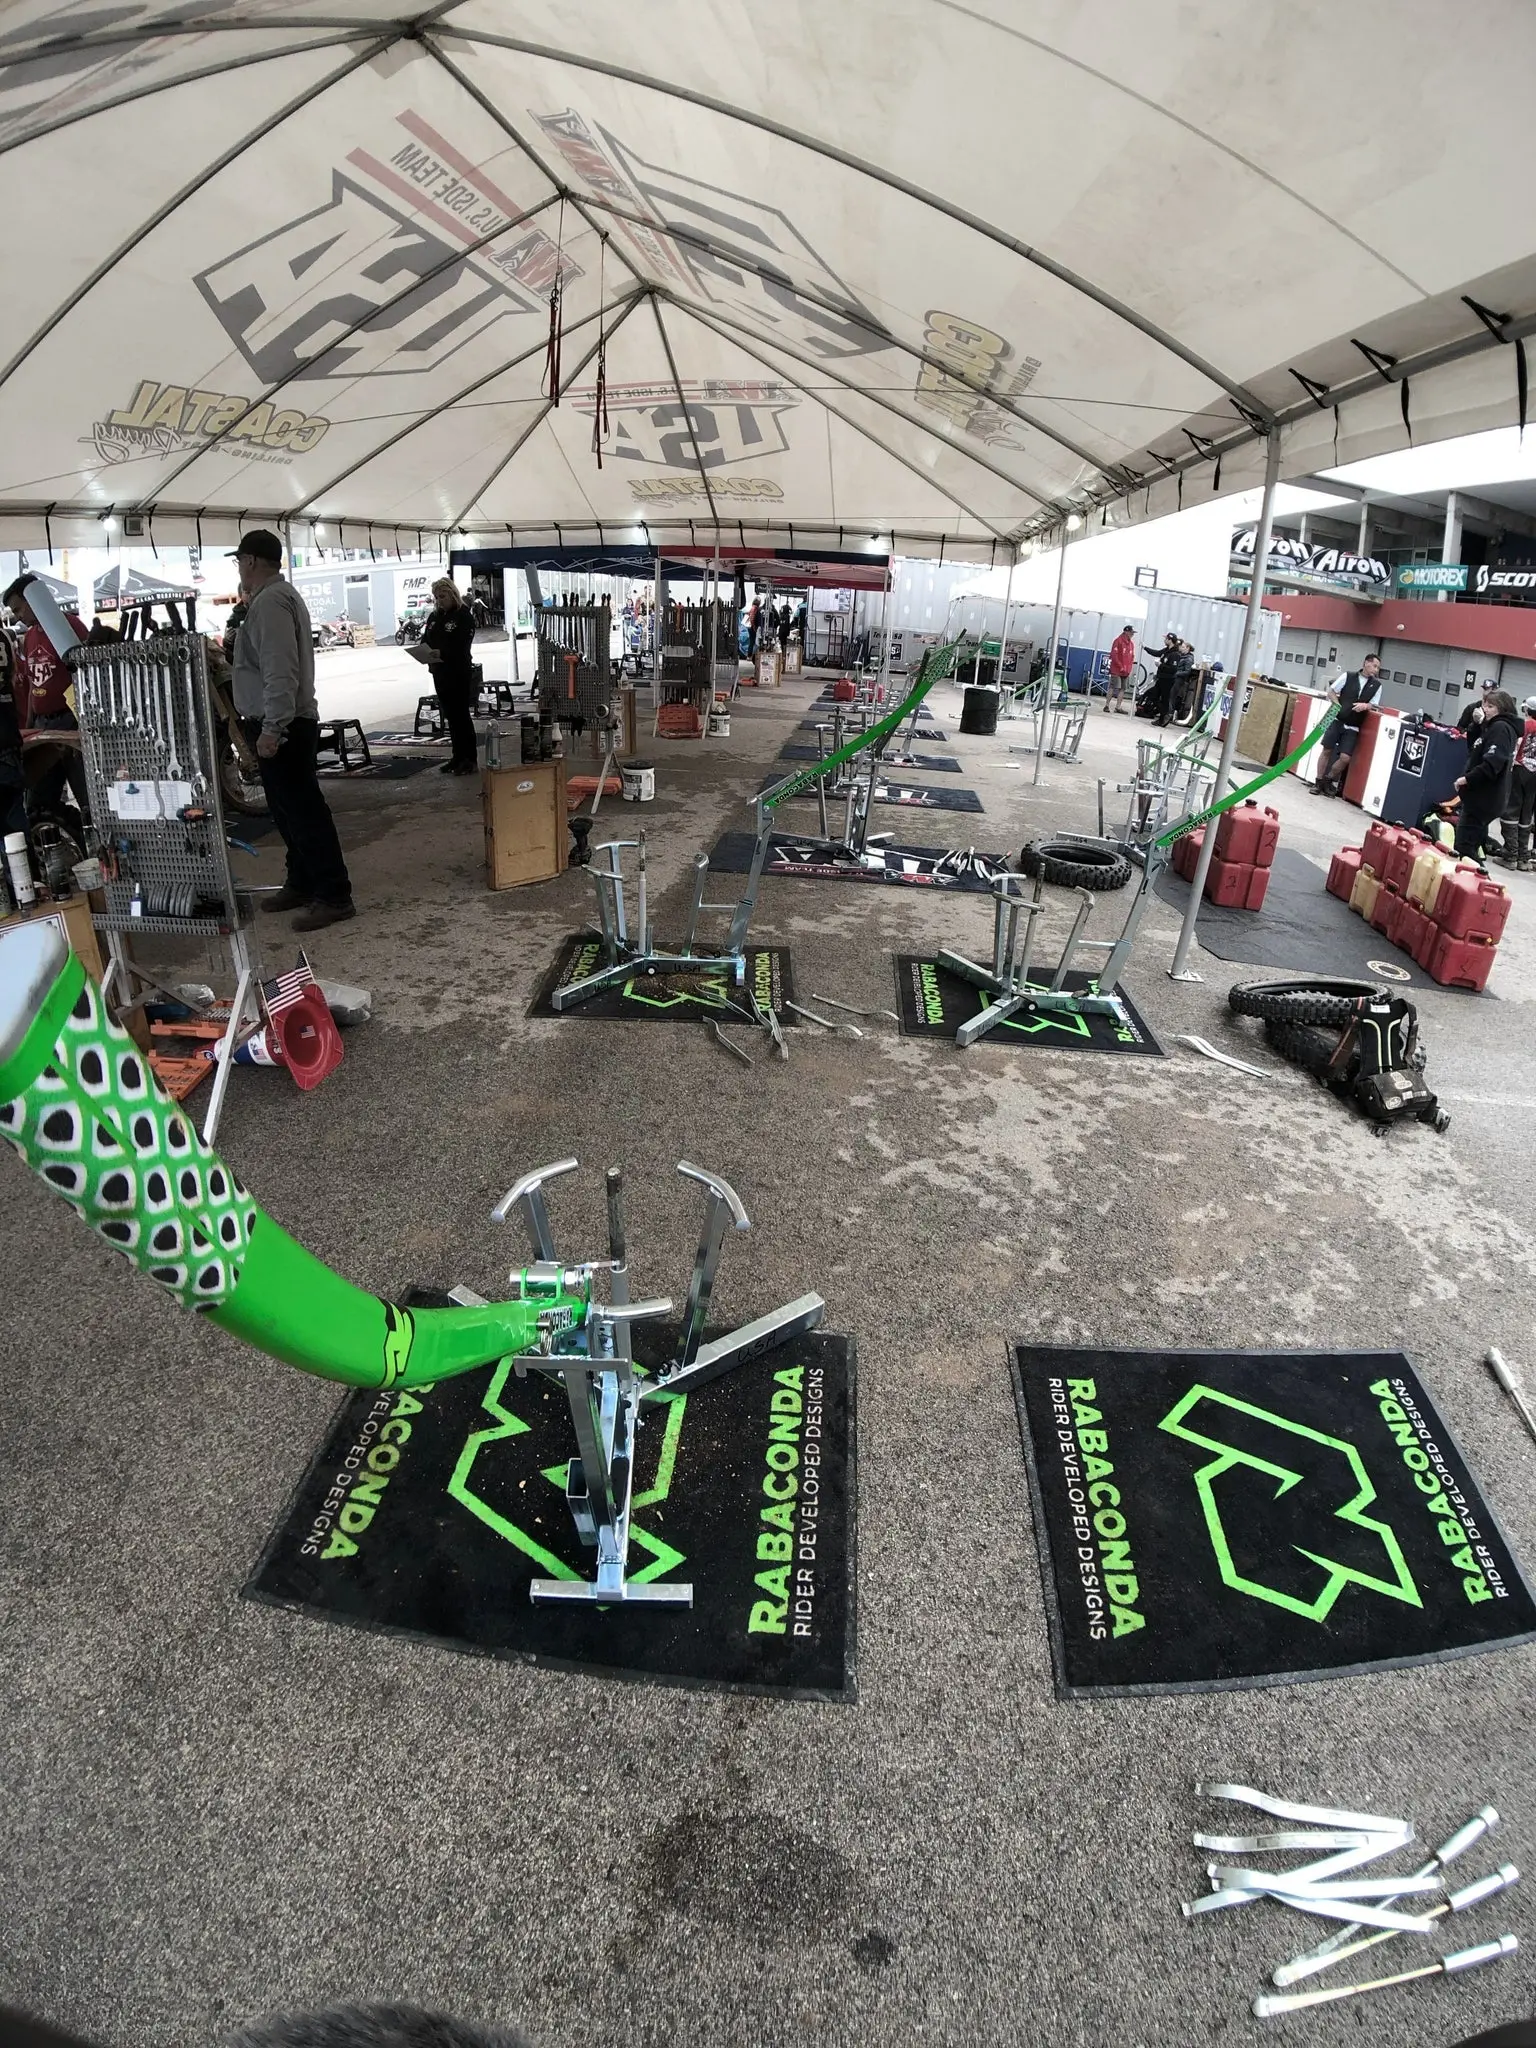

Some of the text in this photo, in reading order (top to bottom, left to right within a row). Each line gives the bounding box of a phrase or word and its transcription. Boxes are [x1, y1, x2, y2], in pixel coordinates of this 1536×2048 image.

[1235, 531, 1310, 560] Aron
[1315, 549, 1387, 578] Airon
[1413, 567, 1467, 587] MOTOREX
[773, 771, 819, 804] RABACONDA
[1168, 811, 1213, 842] RABACONDA
[1264, 831, 1278, 849] 2
[569, 943, 600, 984] RABACO
[755, 952, 771, 1012] RABACONDA
[920, 963, 944, 1025] RABACONDA
[300, 1391, 395, 1556] VELOPED DESIGNS
[320, 1383, 436, 1560] ACONDA
[748, 1365, 804, 1635] RABACONDA
[793, 1367, 824, 1637] RIDER DEVELOPED DESIGNS
[1369, 1378, 1494, 1606] RABACONDA
[1391, 1378, 1509, 1598] RIDER DEVELOPED DESIGNS
[1048, 1378, 1107, 1640] RIDER DEVELOPED DESIGNS
[1067, 1378, 1146, 1639] RABACONDA
